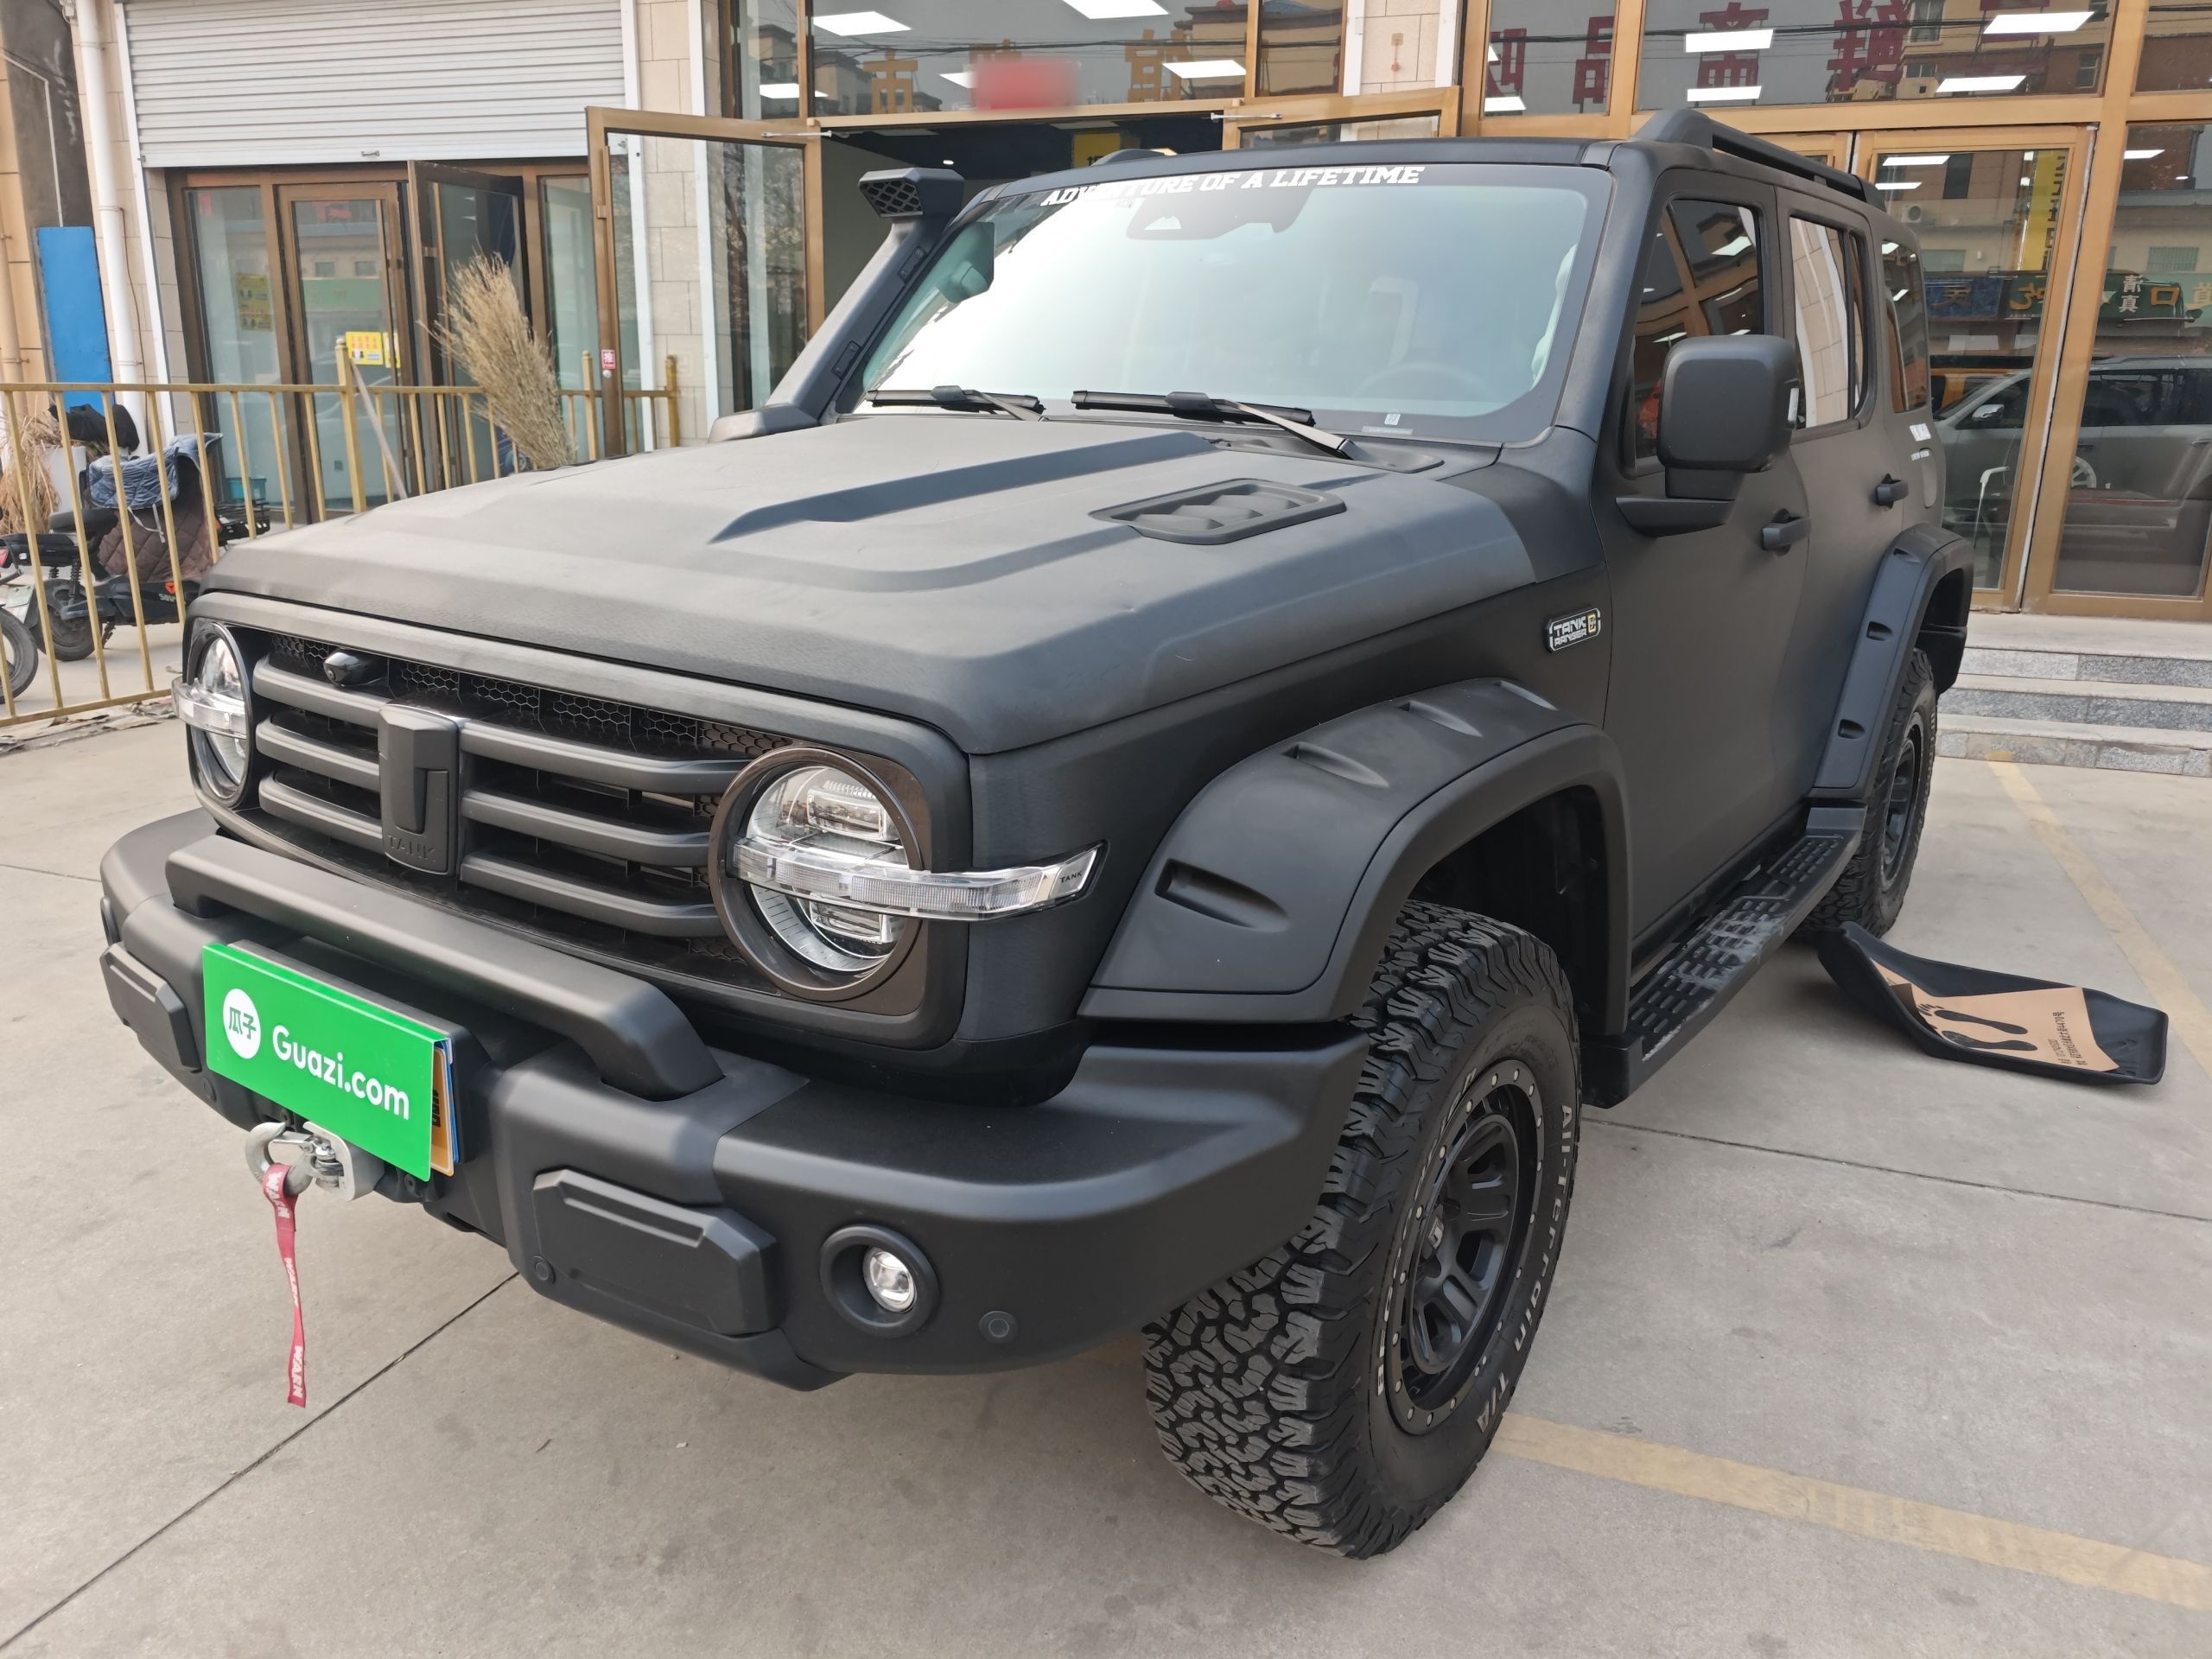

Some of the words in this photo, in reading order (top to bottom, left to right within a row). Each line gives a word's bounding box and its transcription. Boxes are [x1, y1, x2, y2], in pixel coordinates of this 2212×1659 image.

[1039, 175, 1198, 207] ADVTURE
[1199, 173, 1241, 192] OF
[1241, 172, 1263, 188] A
[1269, 166, 1426, 188] LIFETIME
[1554, 615, 1586, 637] TANK
[1554, 627, 1587, 646] RANGER
[1060, 871, 1082, 883] TANK
[227, 1006, 257, 1040] 瓜子
[272, 1025, 410, 1121] Guazi.com
[291, 1345, 303, 1398] WARN
